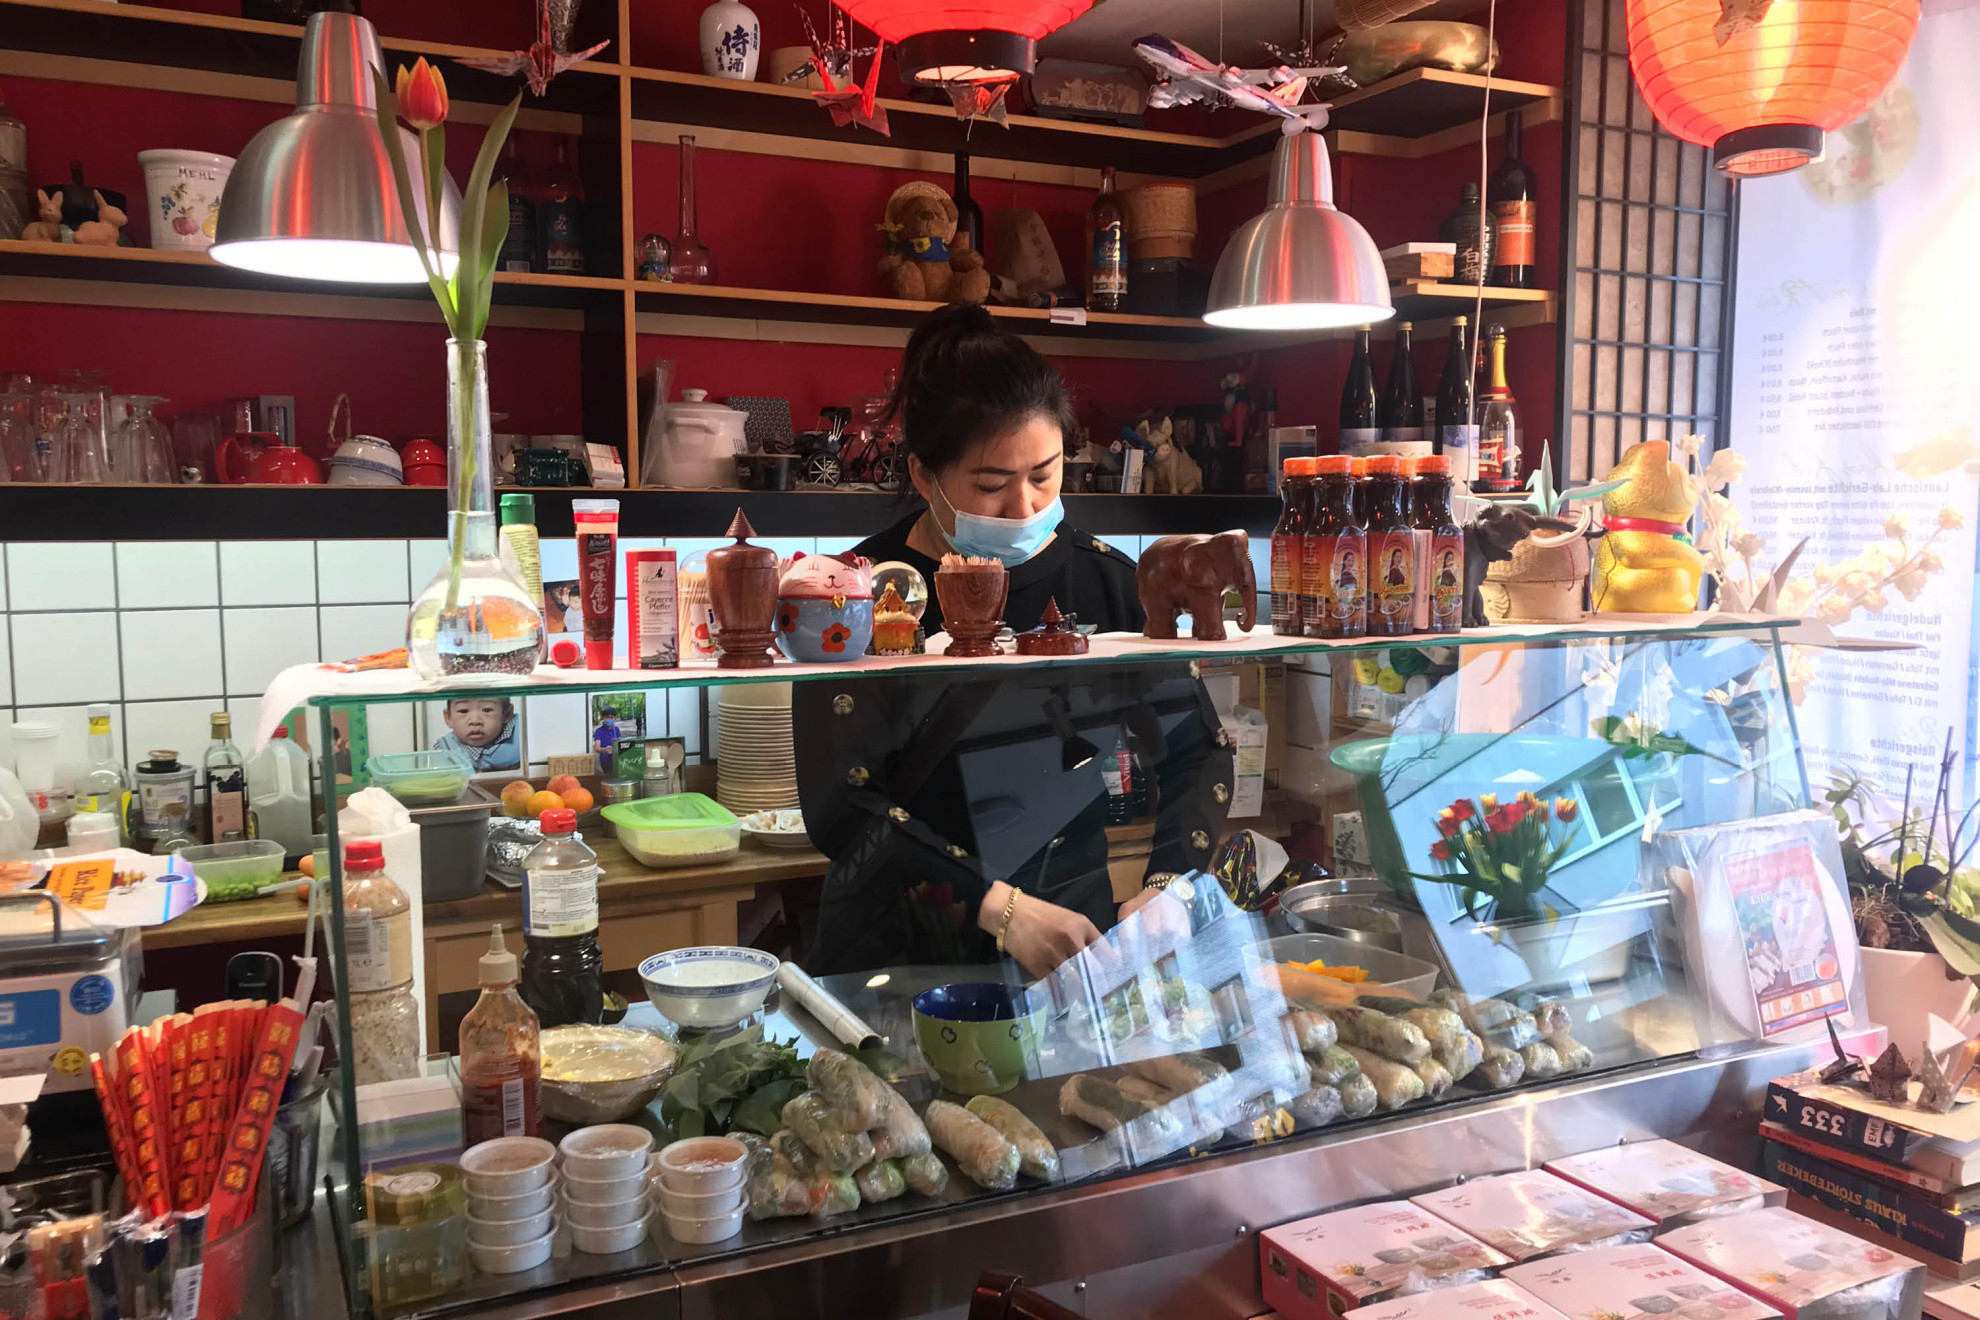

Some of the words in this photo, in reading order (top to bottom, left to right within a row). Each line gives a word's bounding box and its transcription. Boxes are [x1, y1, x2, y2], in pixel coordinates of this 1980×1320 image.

[179, 168, 216, 181] MEHL
[1123, 753, 1131, 783] Vittel
[1800, 1105, 1845, 1137] 333
[1777, 1159, 1862, 1206] STÖRTEBEKER
[1864, 1198, 1907, 1226] KLAUS
